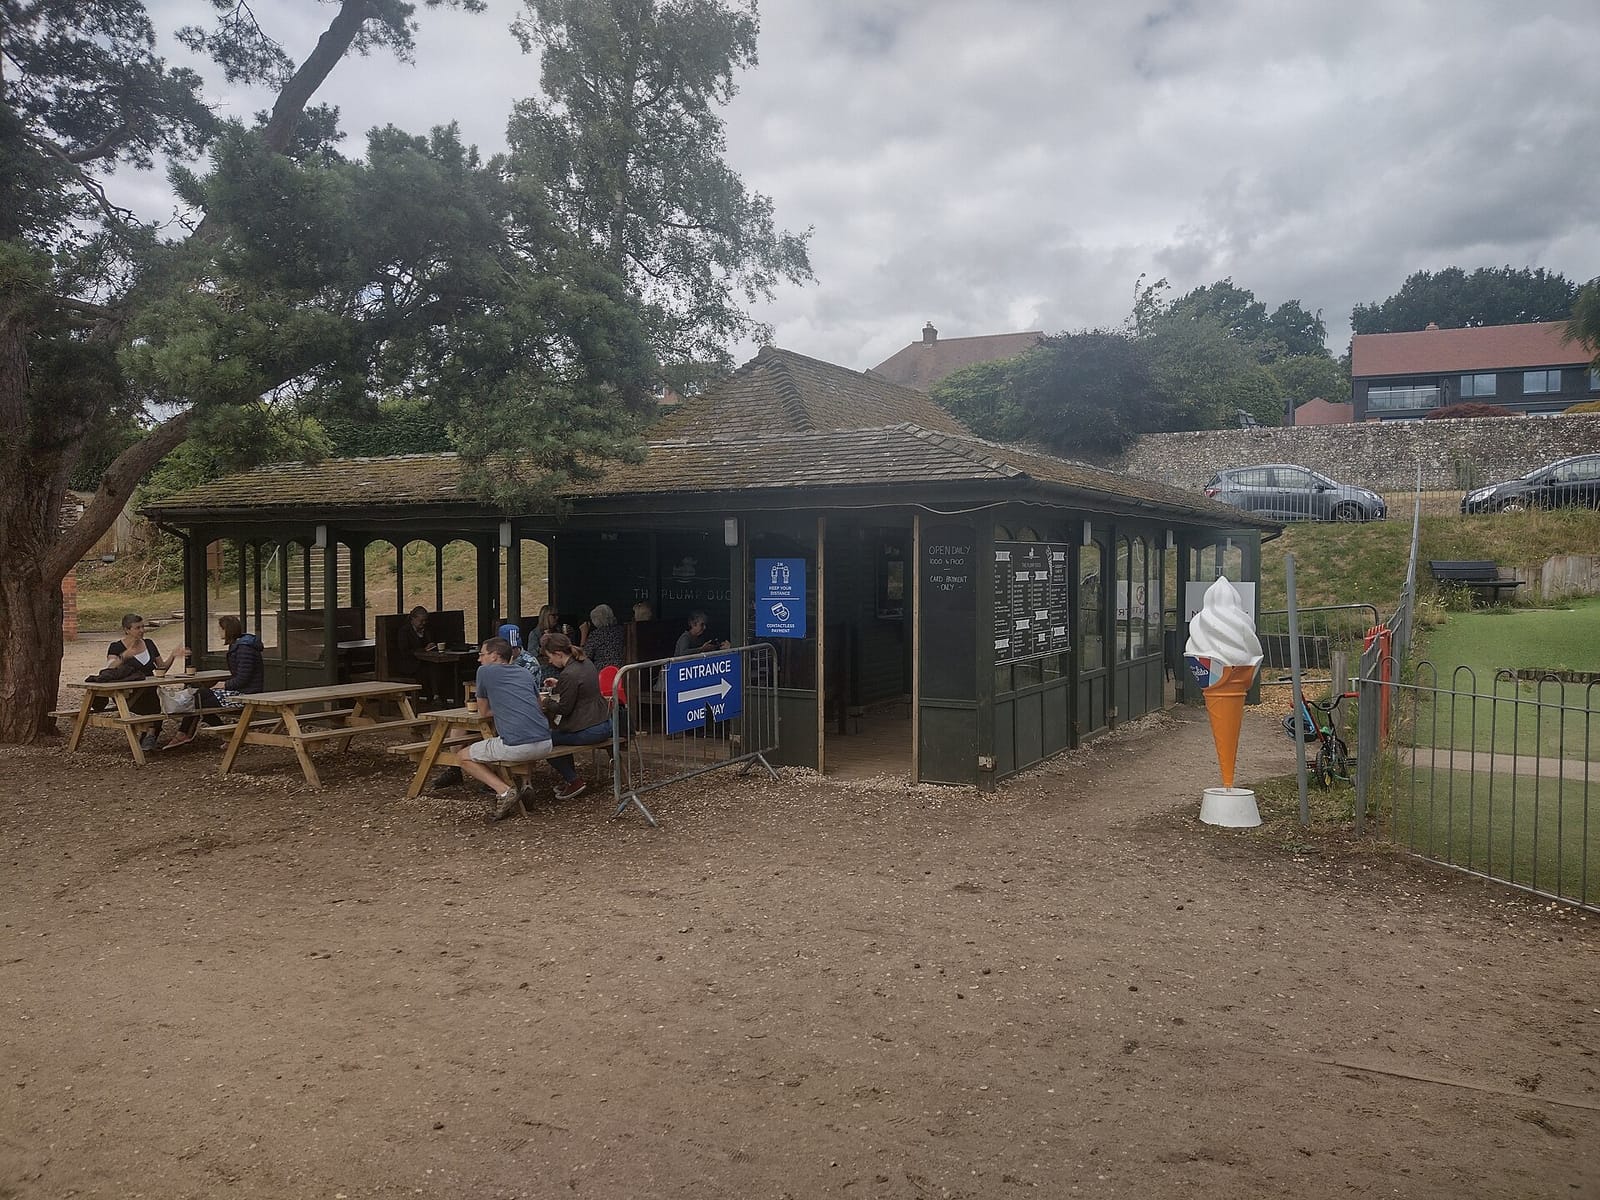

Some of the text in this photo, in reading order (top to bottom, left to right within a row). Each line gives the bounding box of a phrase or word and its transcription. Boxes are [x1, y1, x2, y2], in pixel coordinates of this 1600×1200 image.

[929, 544, 971, 555] OPEN DAILY
[930, 575, 968, 583] CARD PAYMENT
[679, 660, 731, 681] ENTRANCE
[686, 708, 705, 722] ONE
